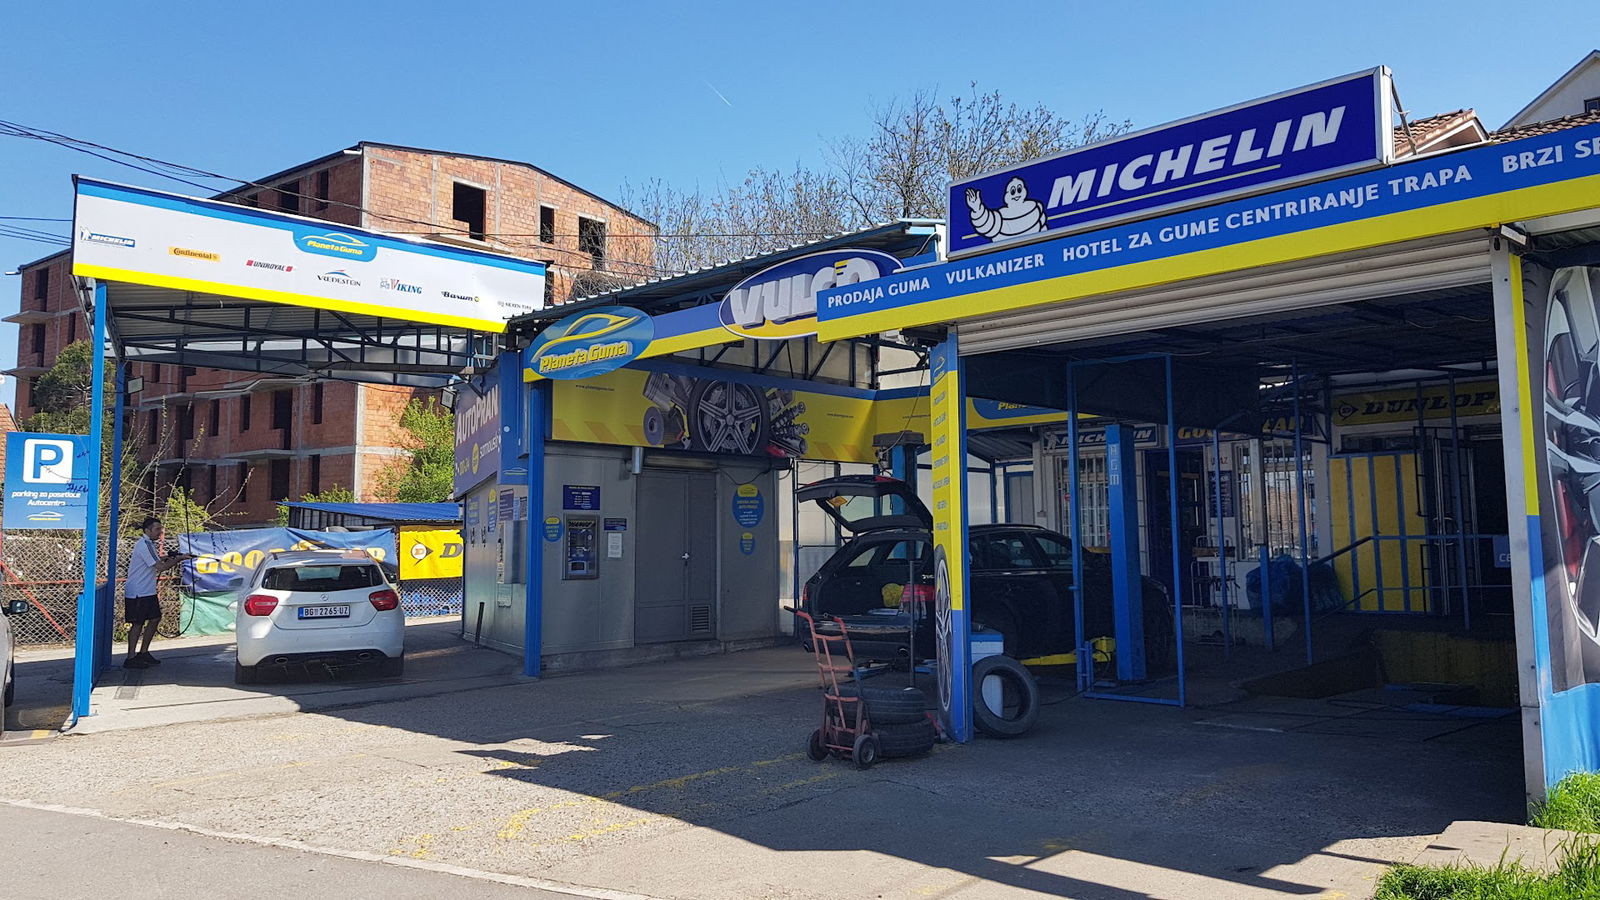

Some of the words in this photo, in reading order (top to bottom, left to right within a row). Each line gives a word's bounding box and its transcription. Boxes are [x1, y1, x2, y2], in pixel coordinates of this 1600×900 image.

[1046, 106, 1346, 209] MICHELIN
[828, 286, 884, 308] PRODAJA
[889, 278, 930, 296] GUMA
[946, 254, 1045, 284] VULKANIZER
[1063, 238, 1122, 262] HOTEL
[1128, 233, 1153, 249] ZA
[1159, 217, 1220, 243] GUME
[1226, 184, 1379, 229] CENTRIRANJE
[1388, 165, 1472, 196] TRAPA
[1502, 144, 1563, 173] BRZI
[174, 247, 212, 259] Continental
[306, 240, 339, 251] Planeta
[340, 246, 363, 255] Guma
[253, 261, 285, 271] UNIROYAL
[317, 275, 361, 287] VREDESTEIN
[390, 279, 422, 294] VIKING
[442, 291, 473, 302] Barum
[540, 348, 589, 373] Planeta
[588, 340, 633, 361] Guma
[32, 444, 64, 479] P
[11, 490, 38, 499] parking
[304, 608, 314, 616] BG
